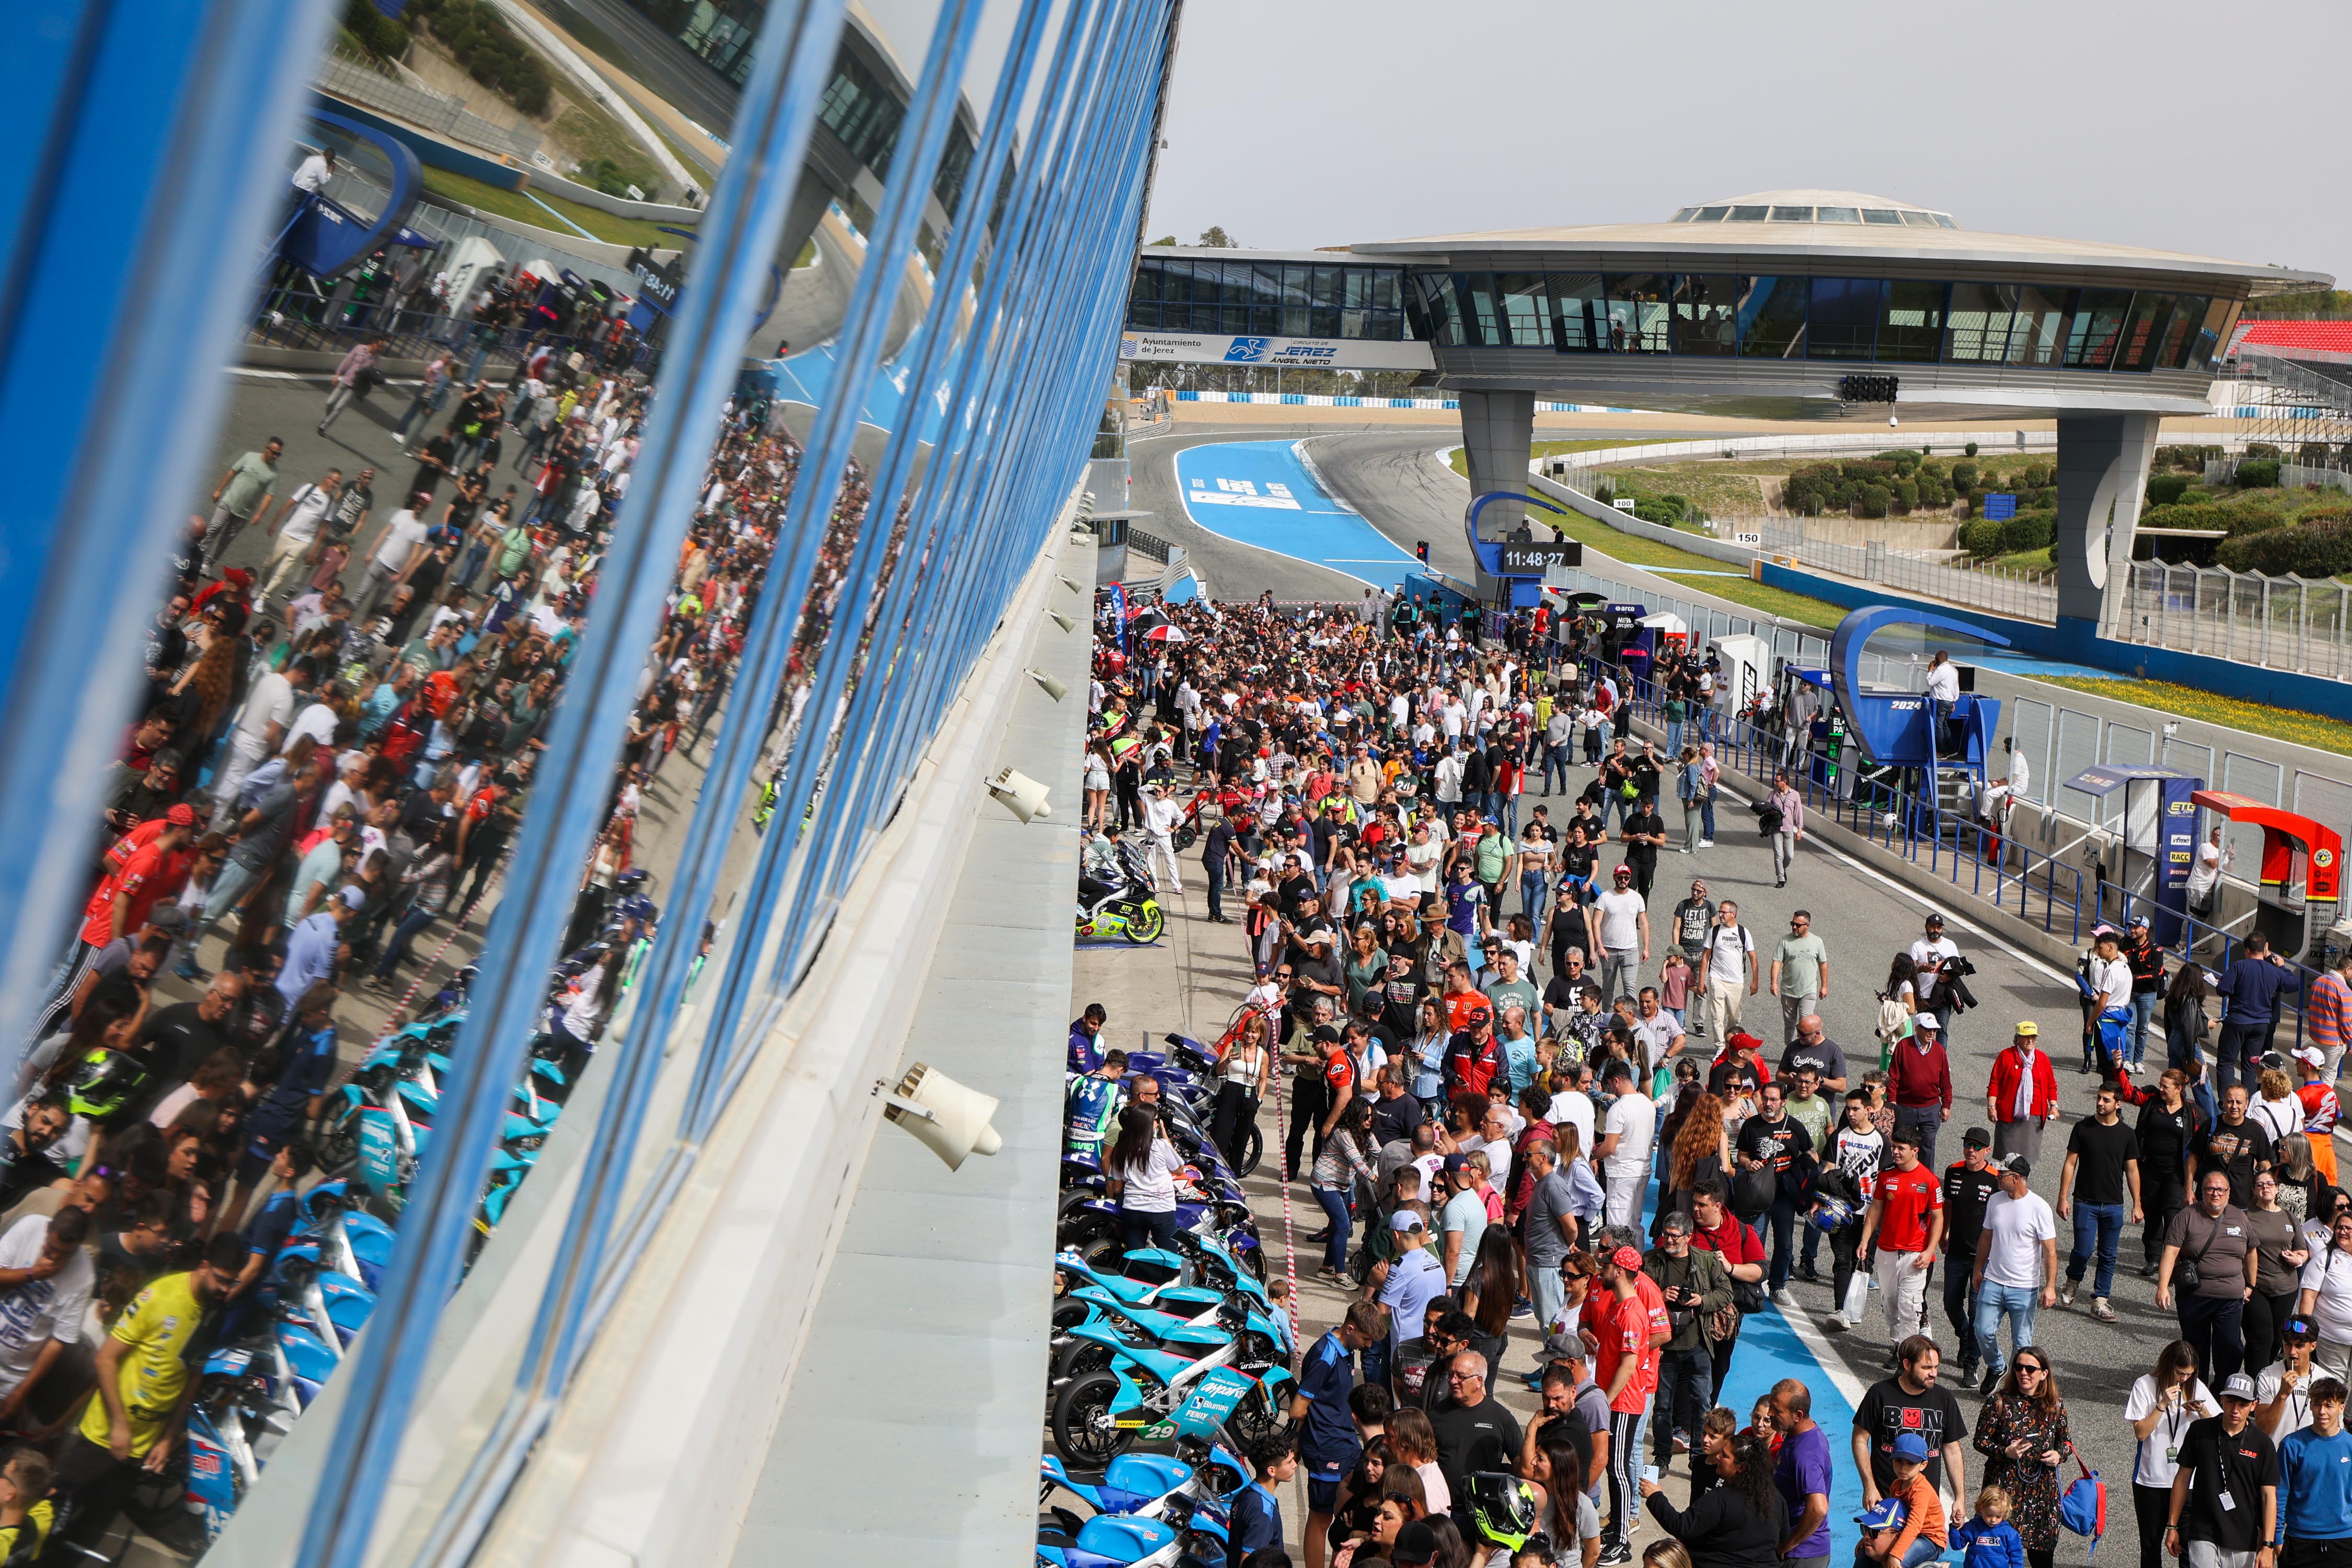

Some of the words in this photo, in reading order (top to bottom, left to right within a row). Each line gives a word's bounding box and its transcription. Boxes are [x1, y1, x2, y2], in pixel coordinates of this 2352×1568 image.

[1142, 338, 1201, 348] Ayuntamiento
[1152, 346, 1175, 354] Jerez
[1274, 346, 1338, 358] JEREZ
[1270, 356, 1301, 365] ÁNGEL
[1738, 534, 1758, 543] 150
[1506, 551, 1564, 567] 11:48:27
[1890, 700, 1922, 710] 2024
[2171, 802, 2196, 812] ETG
[1684, 909, 1697, 921] LET
[1699, 908, 1707, 920] IT
[1684, 919, 1707, 930] SHINE
[1681, 928, 1705, 940] AGAIN
[1471, 1012, 1485, 1021] 63
[1847, 1141, 1873, 1151] SUZUKI
[1057, 1252, 1080, 1265] 32
[2227, 1377, 2247, 1391] JAT
[1203, 1401, 1229, 1413] Blumaq
[1185, 1409, 1208, 1421] FENIX
[1145, 1426, 1174, 1438] 29
[1977, 1537, 2001, 1546] ESBK
